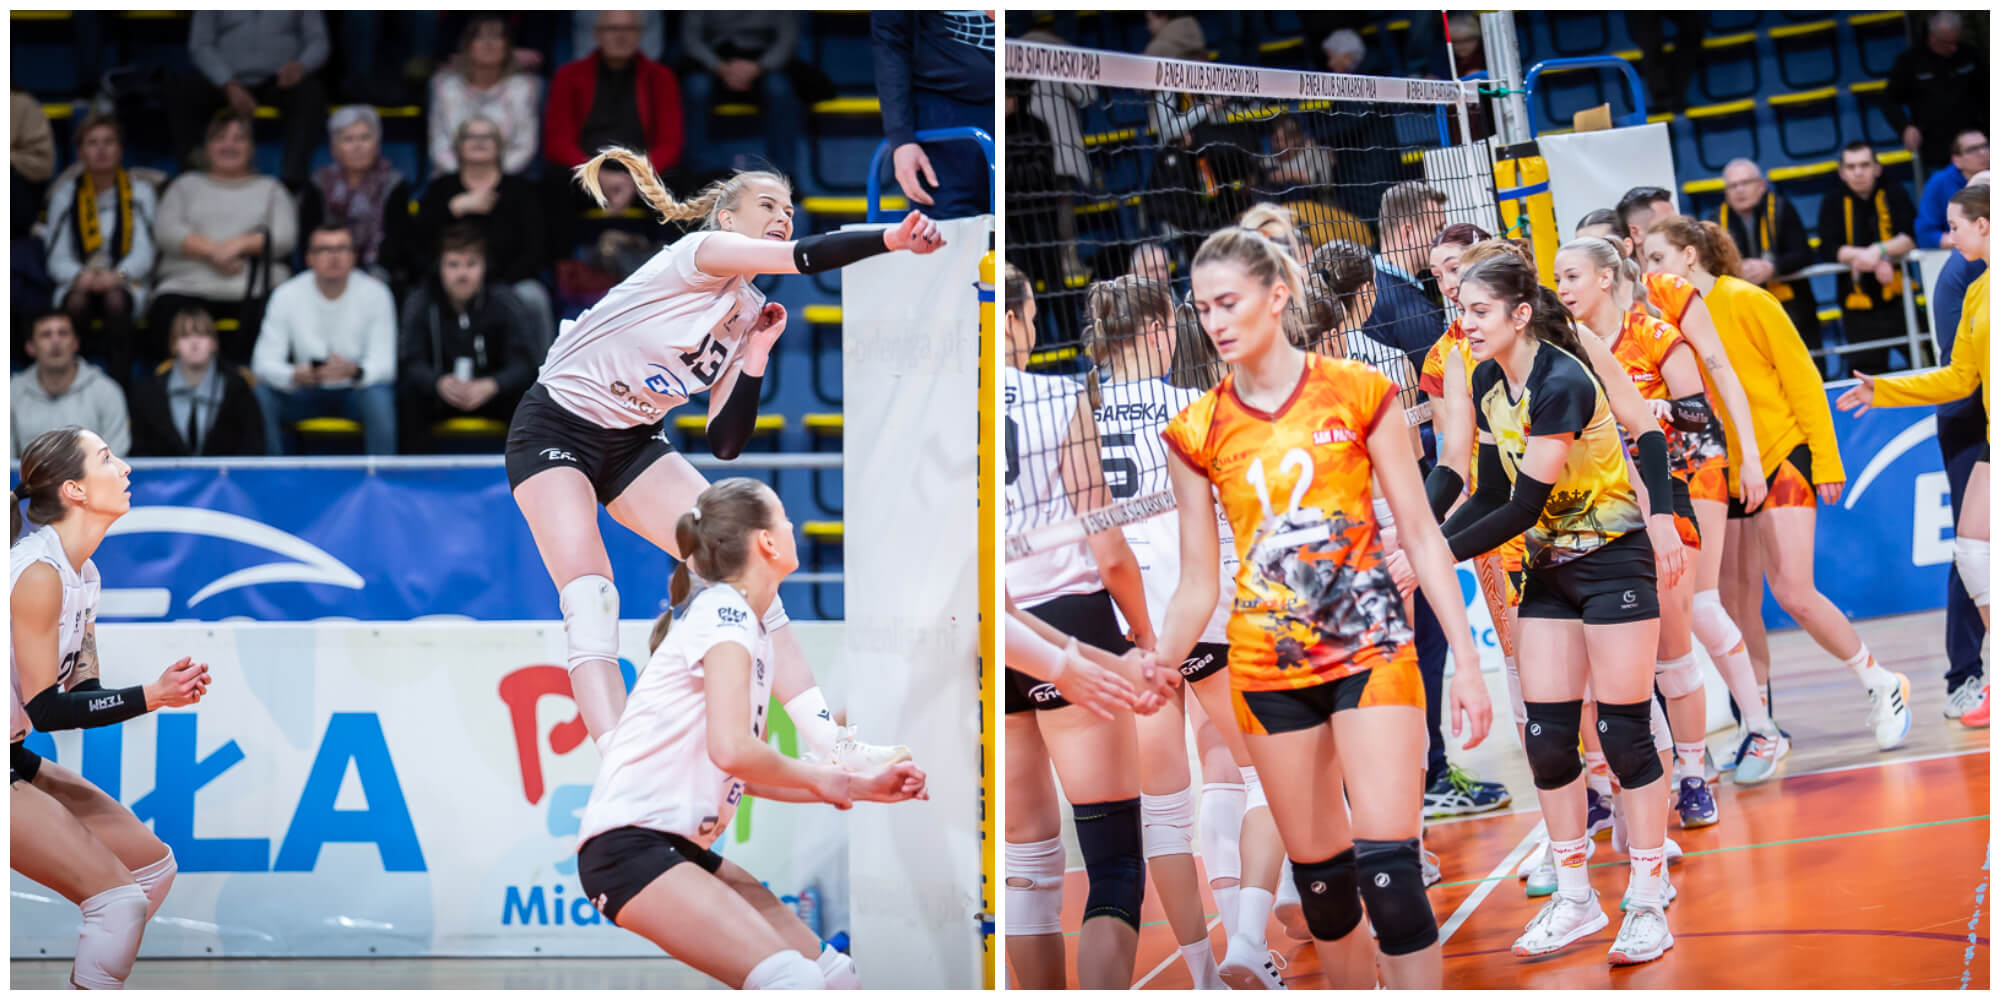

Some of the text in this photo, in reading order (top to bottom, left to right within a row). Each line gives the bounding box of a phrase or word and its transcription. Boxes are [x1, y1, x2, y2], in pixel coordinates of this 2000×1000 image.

[1026, 46, 1080, 80] SIATKARSKI
[1164, 61, 1184, 87] ENEA
[1185, 64, 1204, 89] KLUB
[1246, 448, 1323, 528] 12
[1181, 653, 1215, 676] Enea
[88, 693, 125, 712] TEAM
